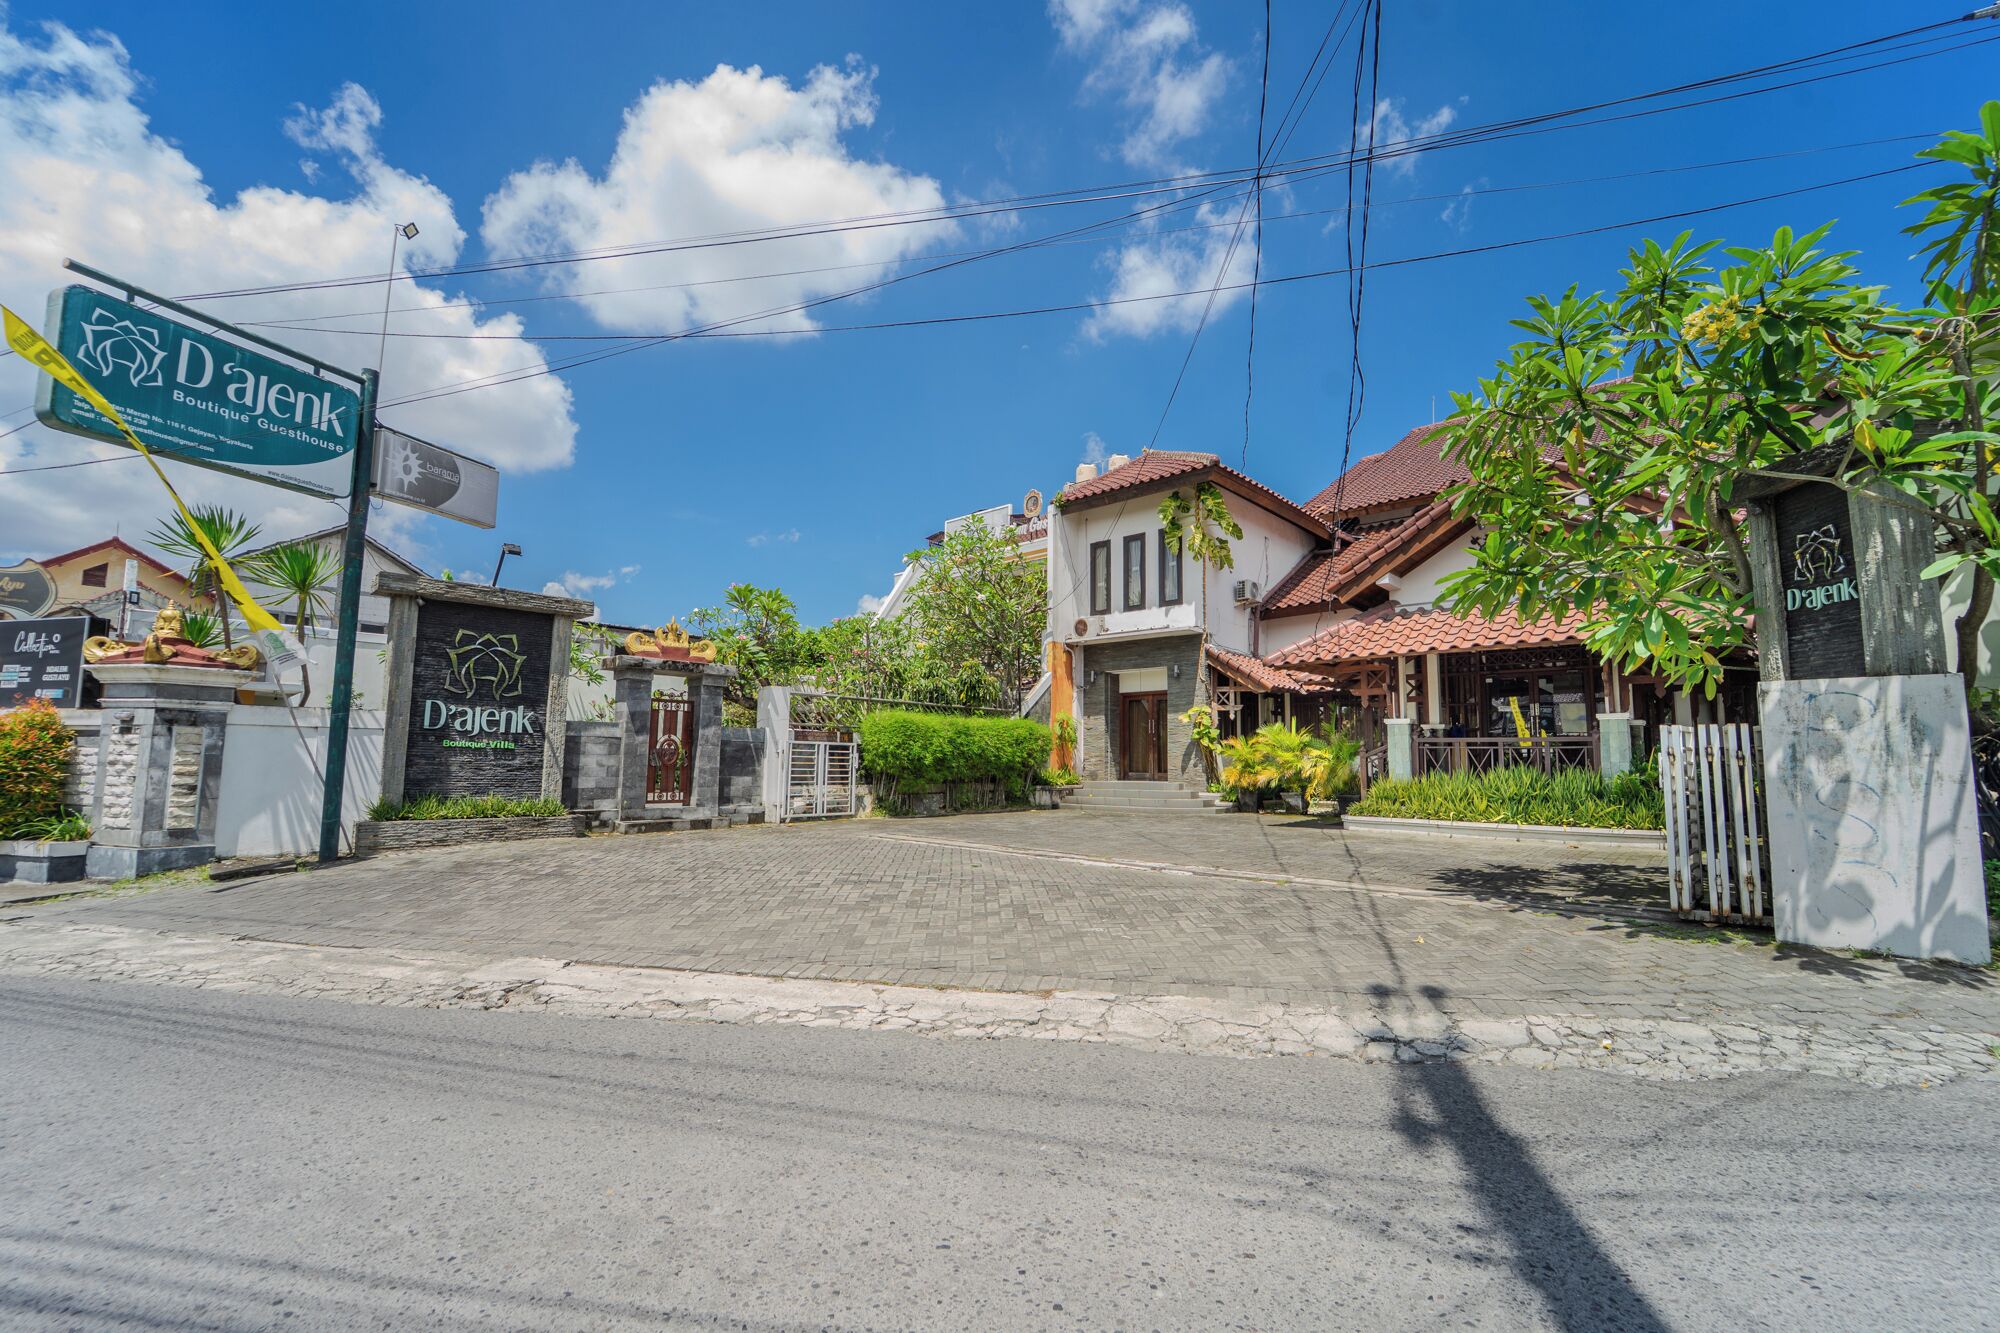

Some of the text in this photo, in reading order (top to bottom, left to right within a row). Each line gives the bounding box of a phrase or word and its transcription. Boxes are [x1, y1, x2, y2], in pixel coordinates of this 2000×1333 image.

[71, 408, 95, 419] email
[151, 415, 165, 424] No.
[173, 389, 344, 453] Boutique Guesthouse
[1786, 577, 1859, 611] D'ajenk
[423, 699, 535, 737] D'ajenk
[442, 739, 516, 750] Boutique Villa
